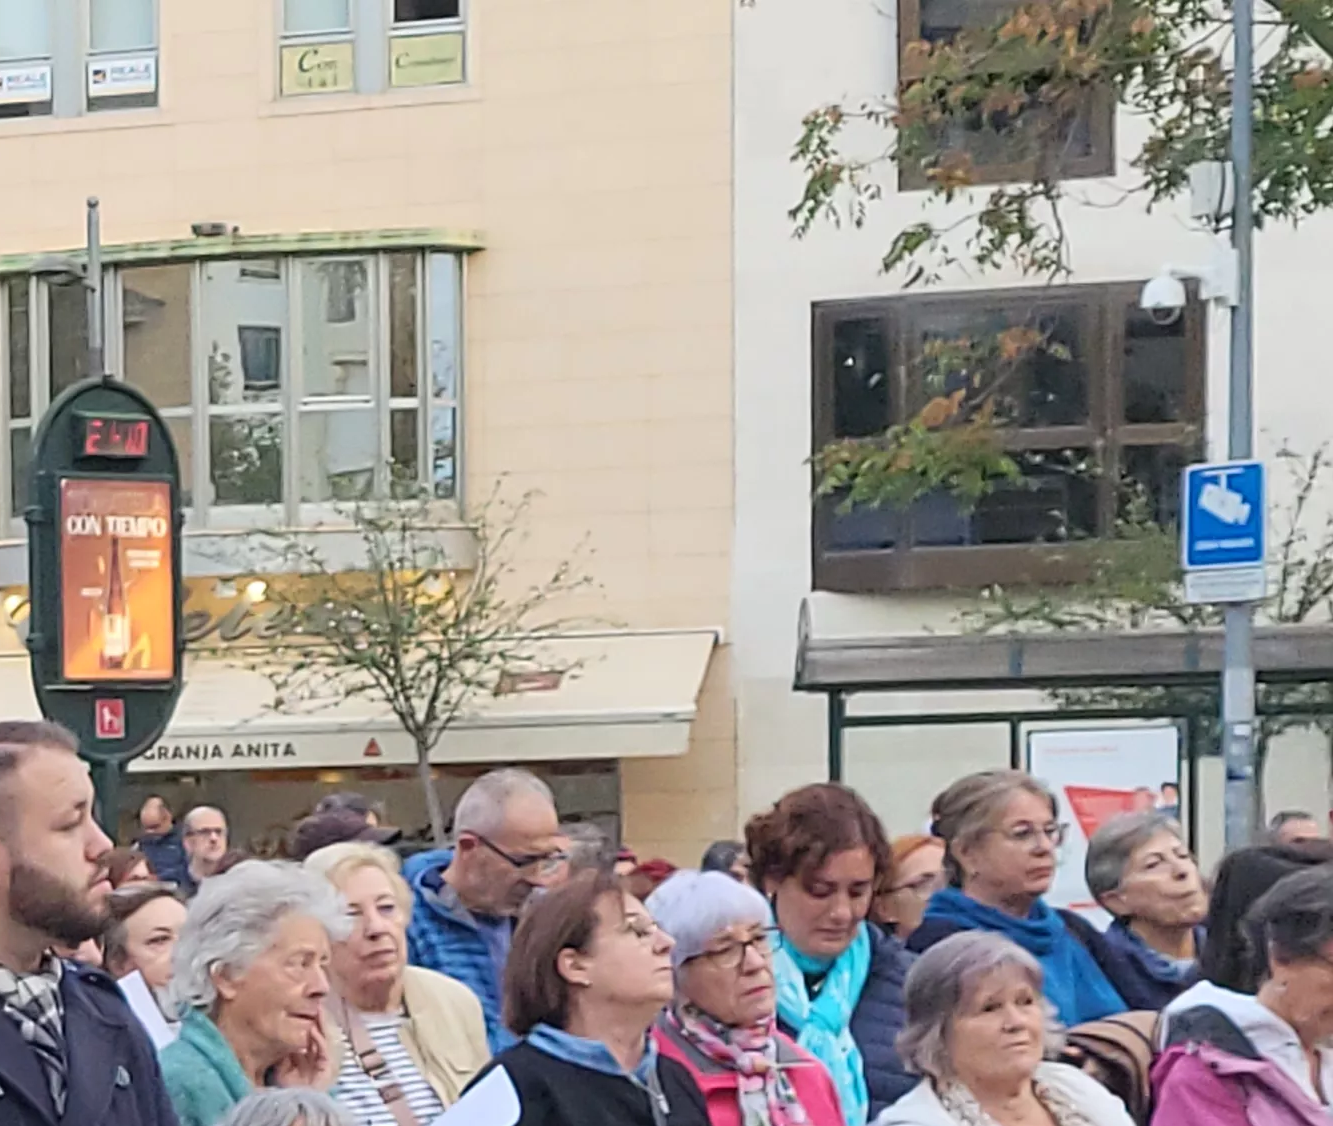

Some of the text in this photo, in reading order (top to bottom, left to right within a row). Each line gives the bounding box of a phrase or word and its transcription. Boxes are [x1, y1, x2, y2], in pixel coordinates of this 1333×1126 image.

[66, 514, 167, 538] CON TIEMPO
[142, 741, 297, 761] GRANJA ANITA
